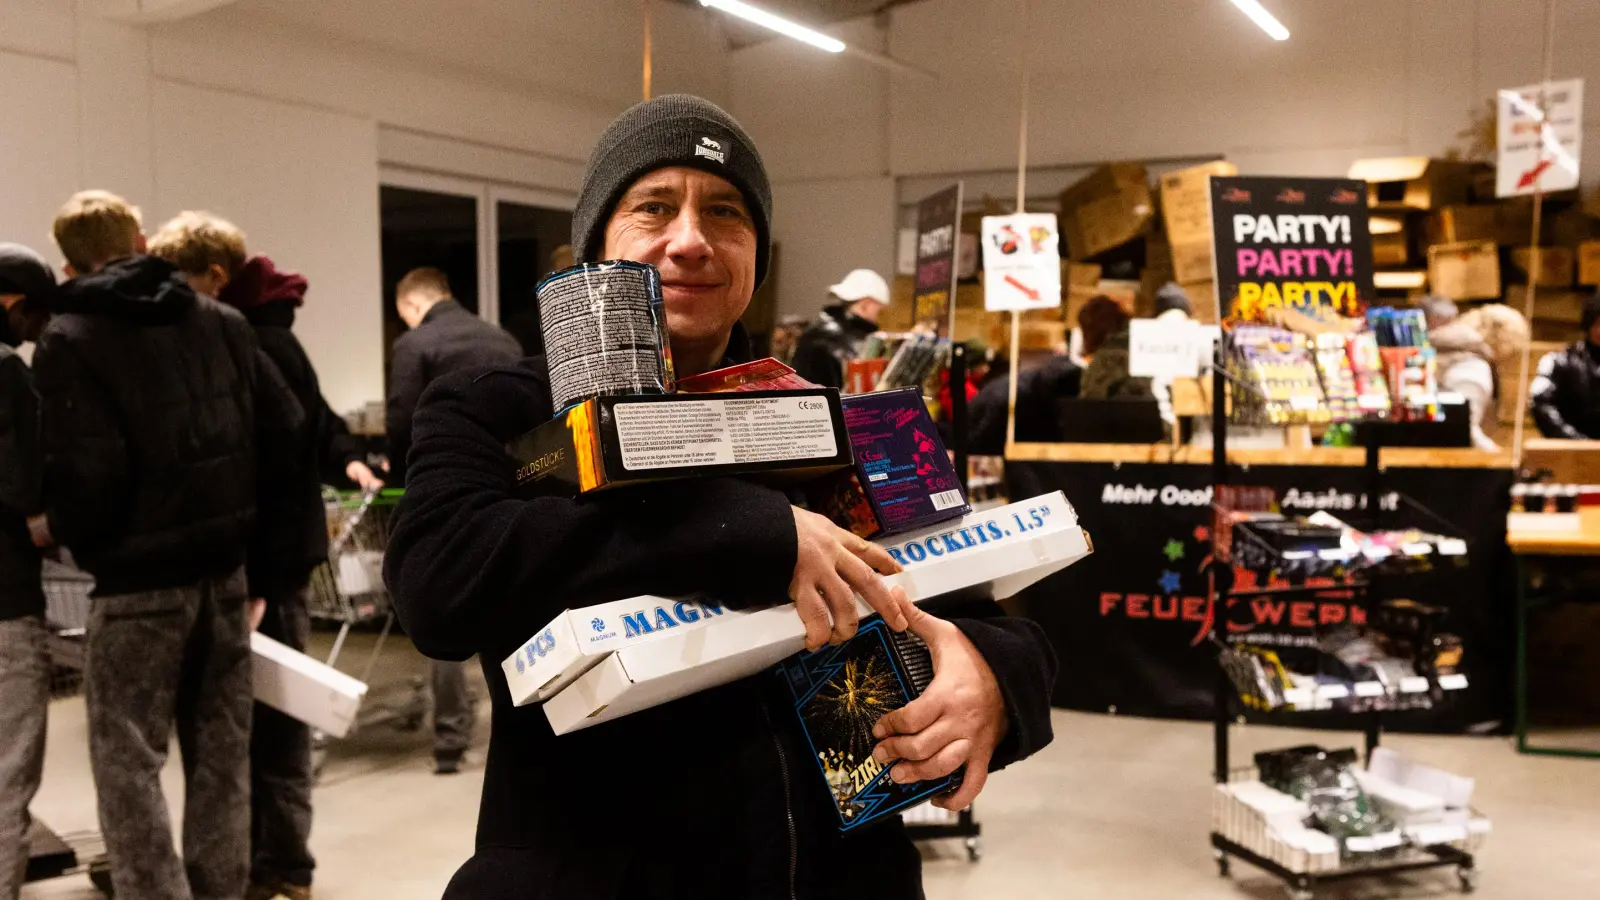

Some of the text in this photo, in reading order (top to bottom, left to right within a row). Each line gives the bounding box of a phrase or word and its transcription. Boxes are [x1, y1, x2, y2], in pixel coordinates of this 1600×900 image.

[1233, 214, 1352, 244] PARTY!
[1237, 248, 1354, 276] PARTY!
[1238, 281, 1357, 310] PARTY!
[1102, 484, 1158, 504] Mehr
[516, 628, 556, 674] 6 PCS
[590, 632, 617, 642] MAGNUM
